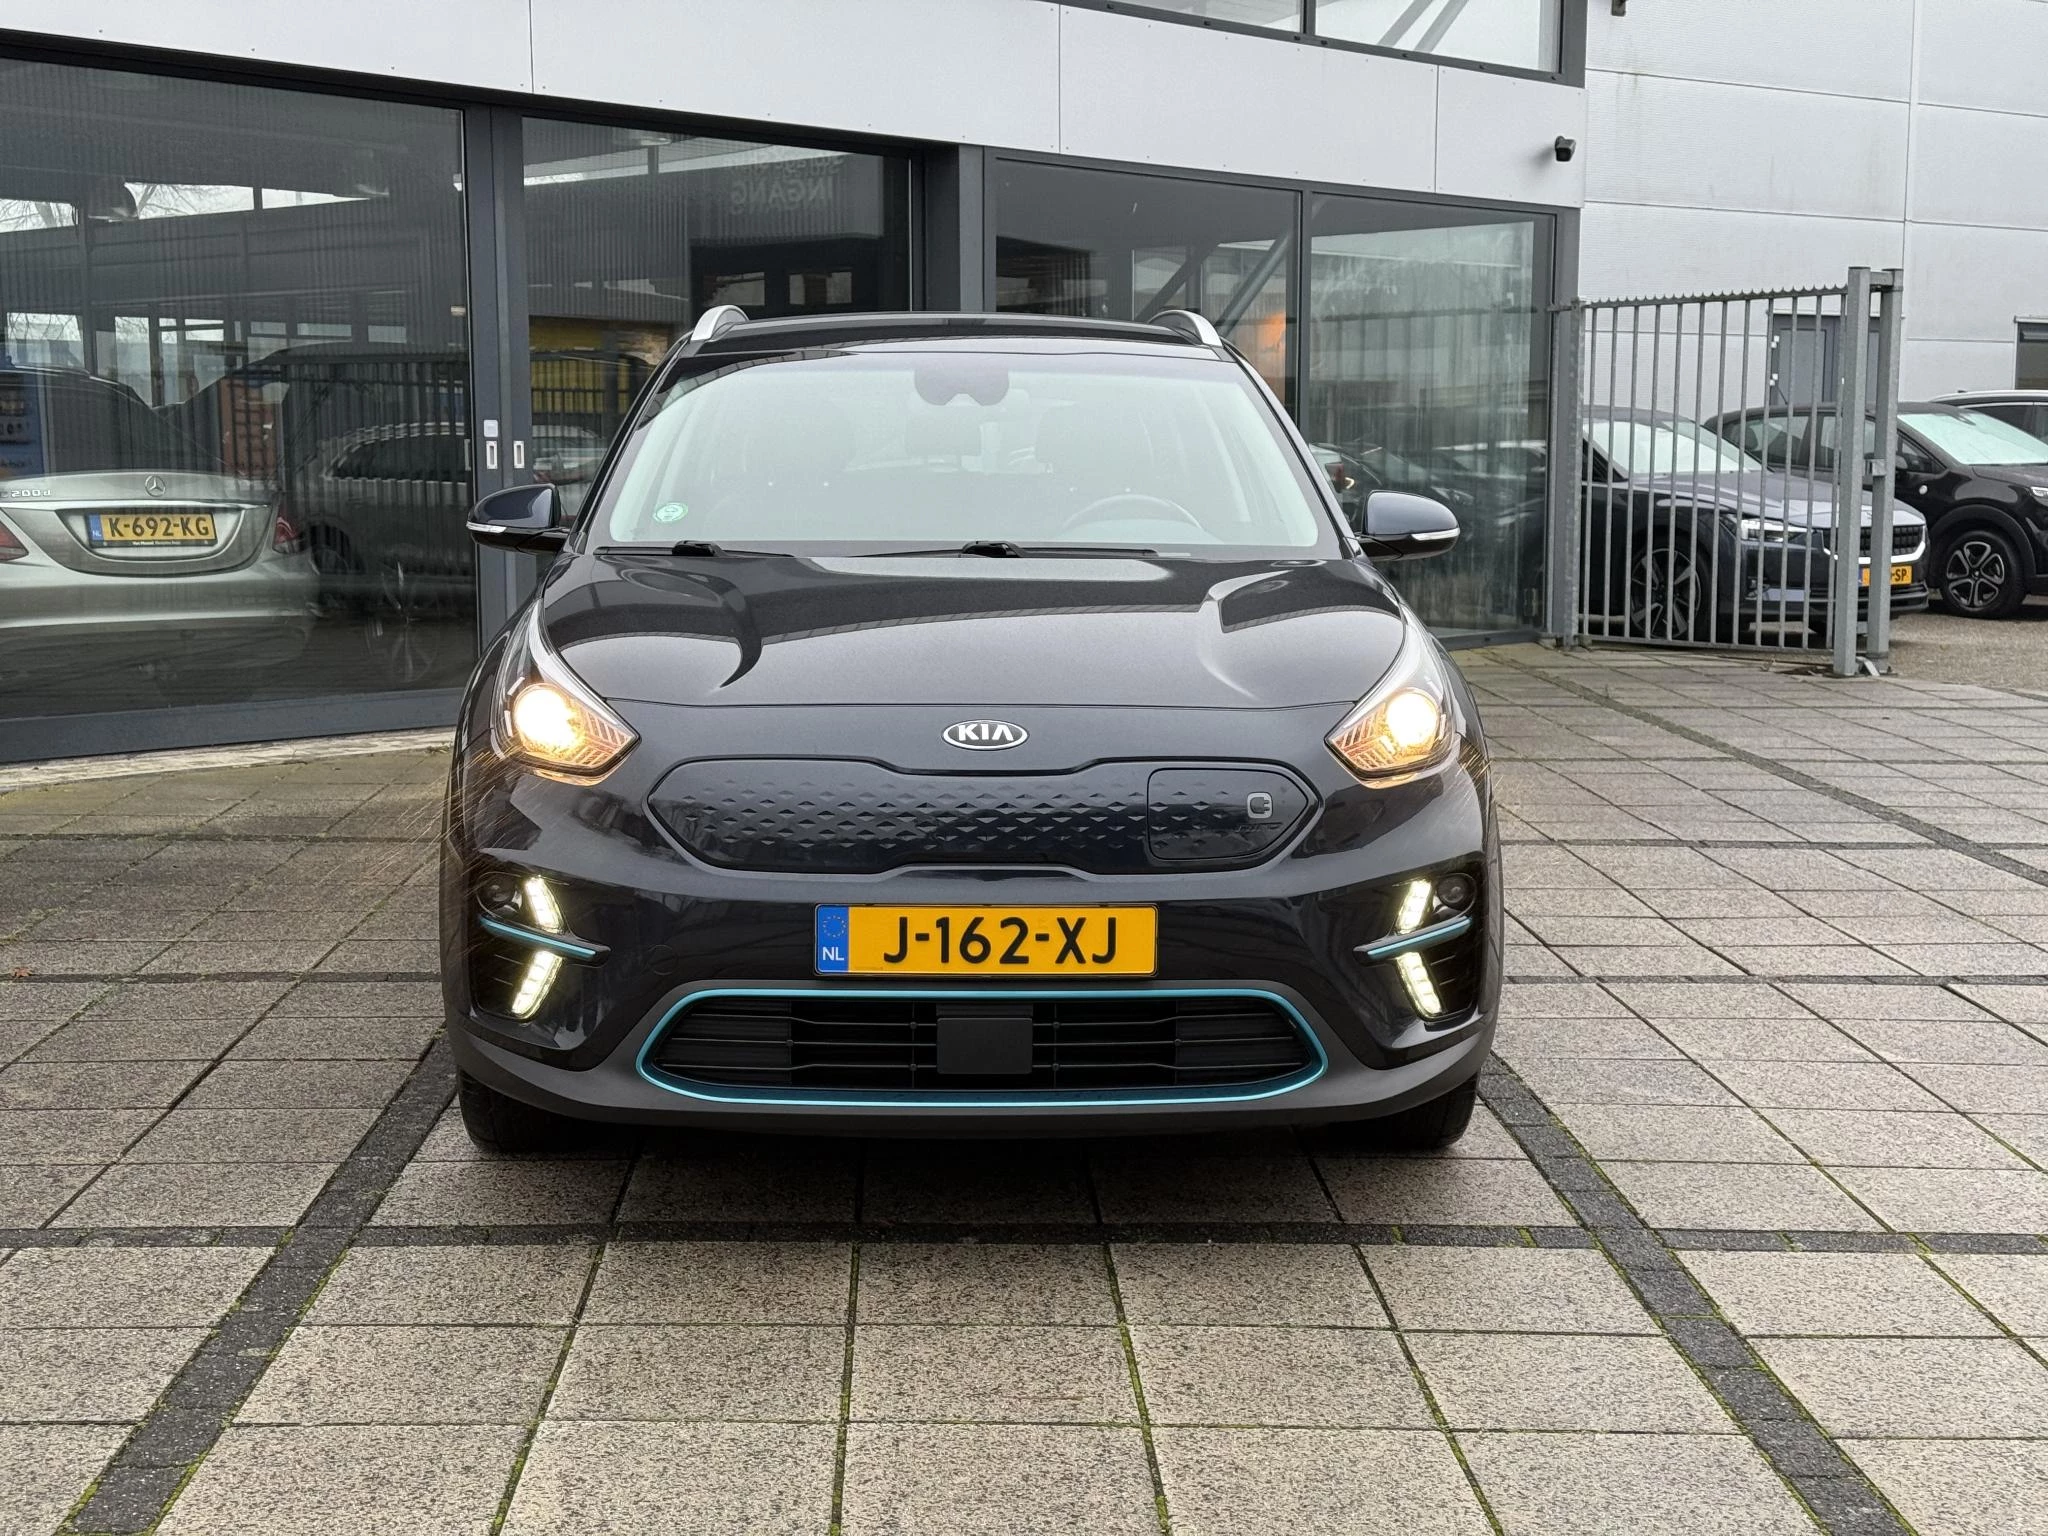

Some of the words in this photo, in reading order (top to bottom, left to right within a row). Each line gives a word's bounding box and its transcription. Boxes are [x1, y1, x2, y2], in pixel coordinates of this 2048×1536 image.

[108, 517, 210, 537] K-692-KG
[957, 723, 1014, 741] KIA
[884, 917, 1117, 964] J-162-XJ
[823, 947, 844, 961] NL
